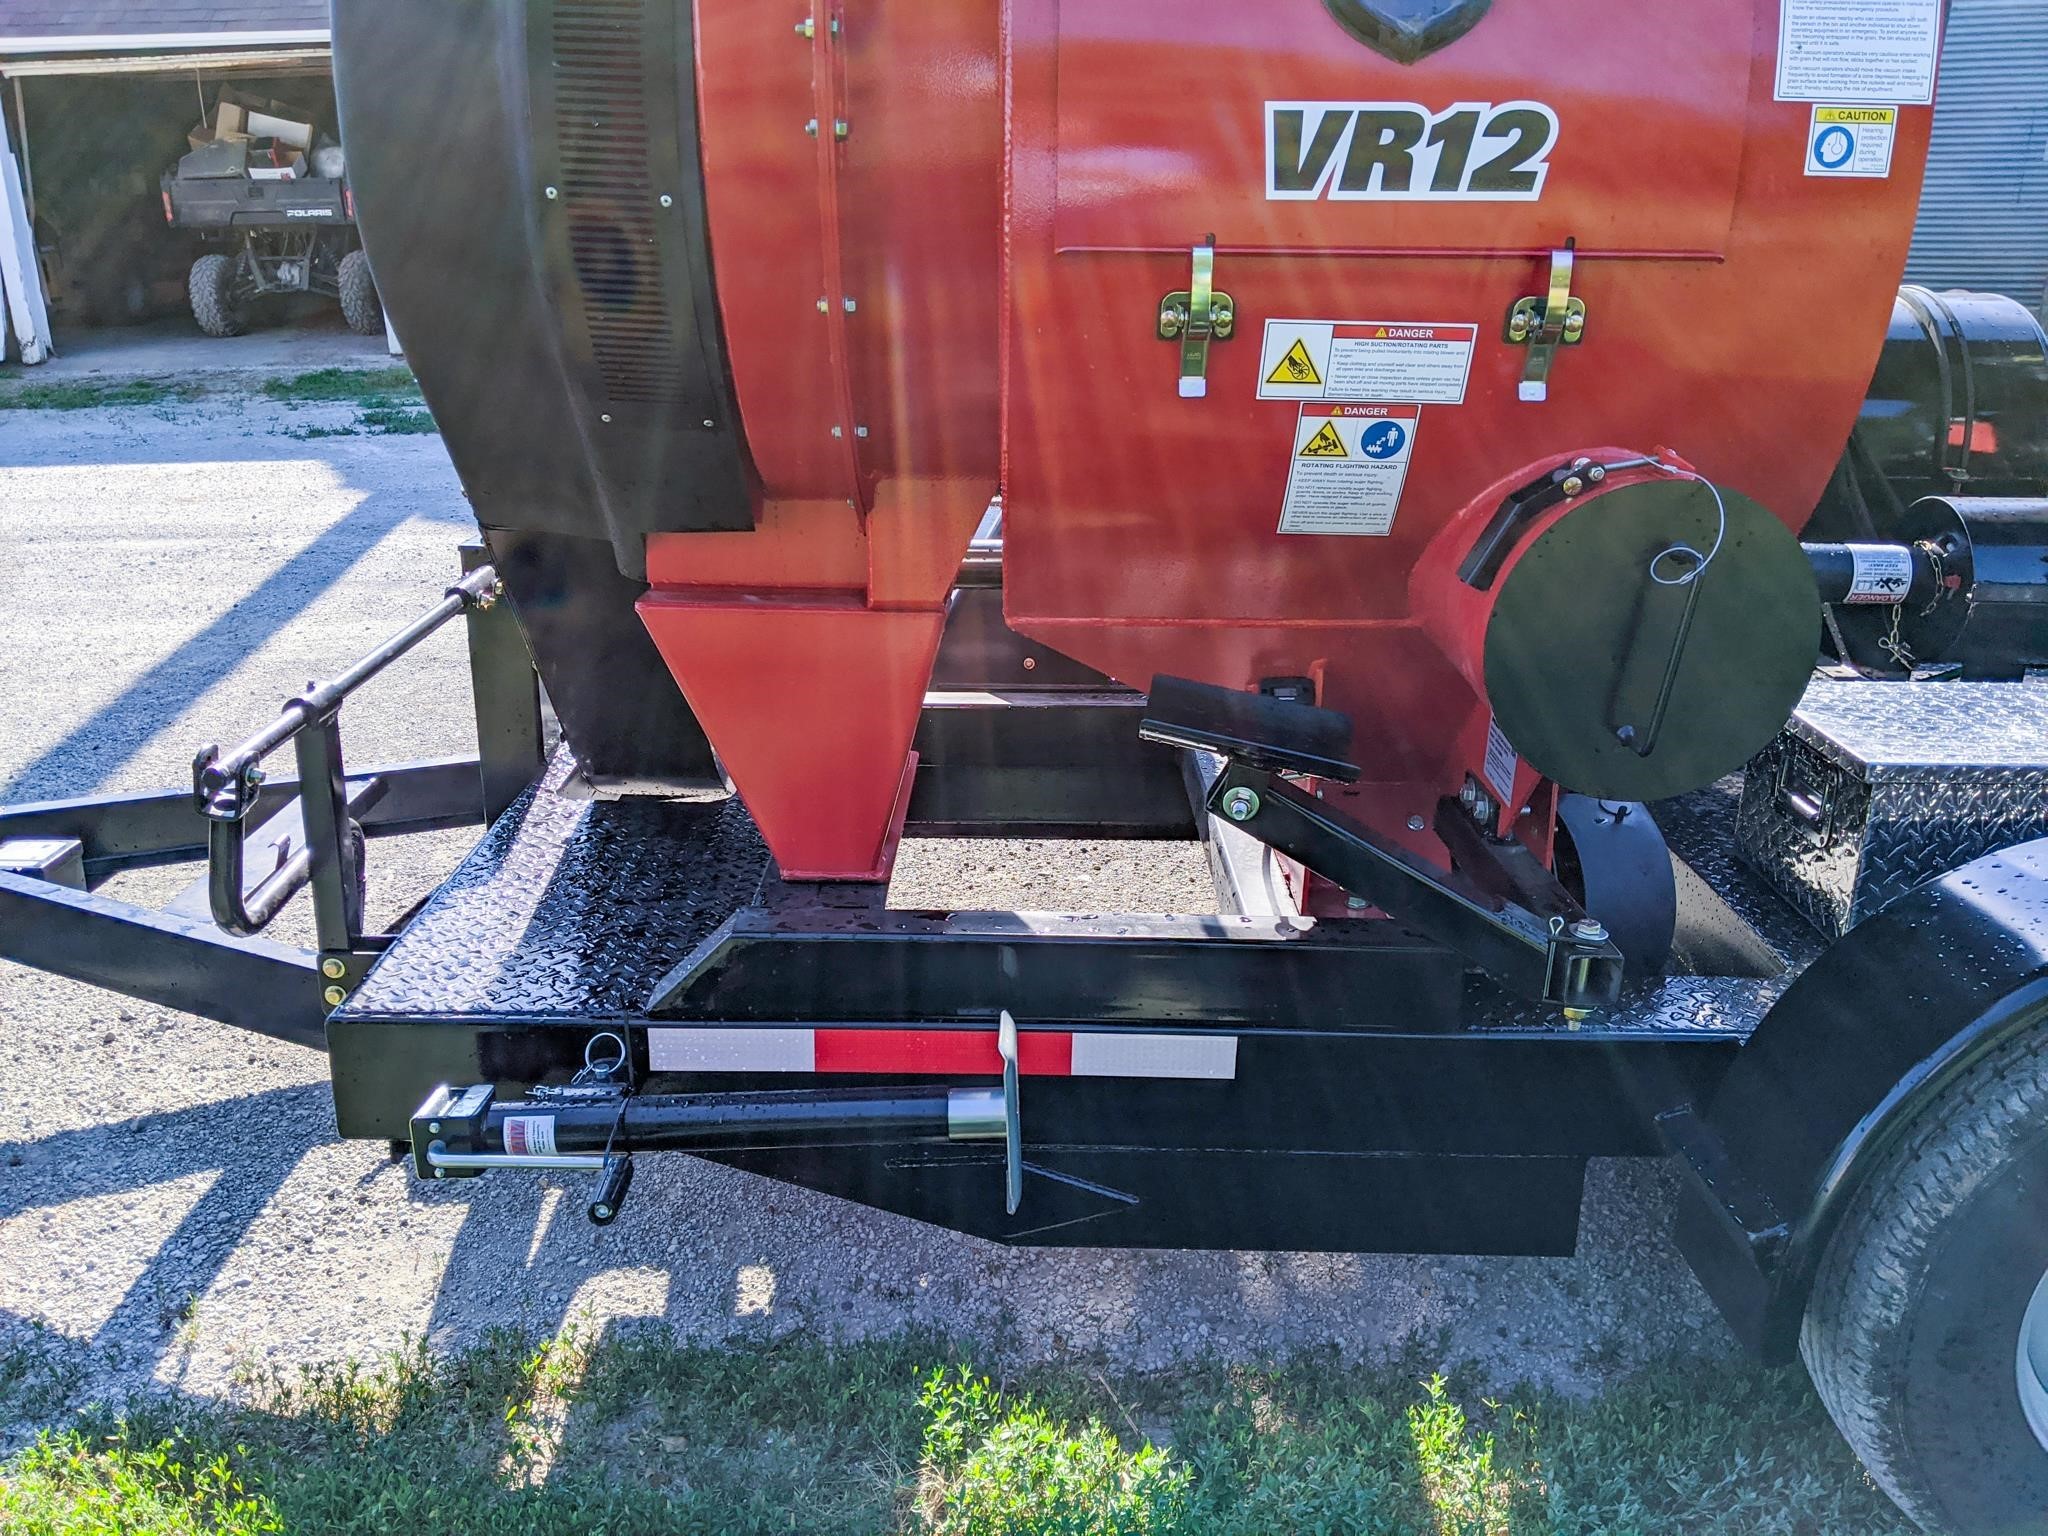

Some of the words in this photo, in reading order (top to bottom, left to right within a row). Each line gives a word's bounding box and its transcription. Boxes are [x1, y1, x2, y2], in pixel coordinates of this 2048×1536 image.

[1838, 111, 1887, 121] CAUTION
[1271, 105, 1553, 194] VR12
[286, 209, 333, 217] POLARIS
[1388, 328, 1433, 338] DANGER
[1344, 407, 1388, 416] DANGER
